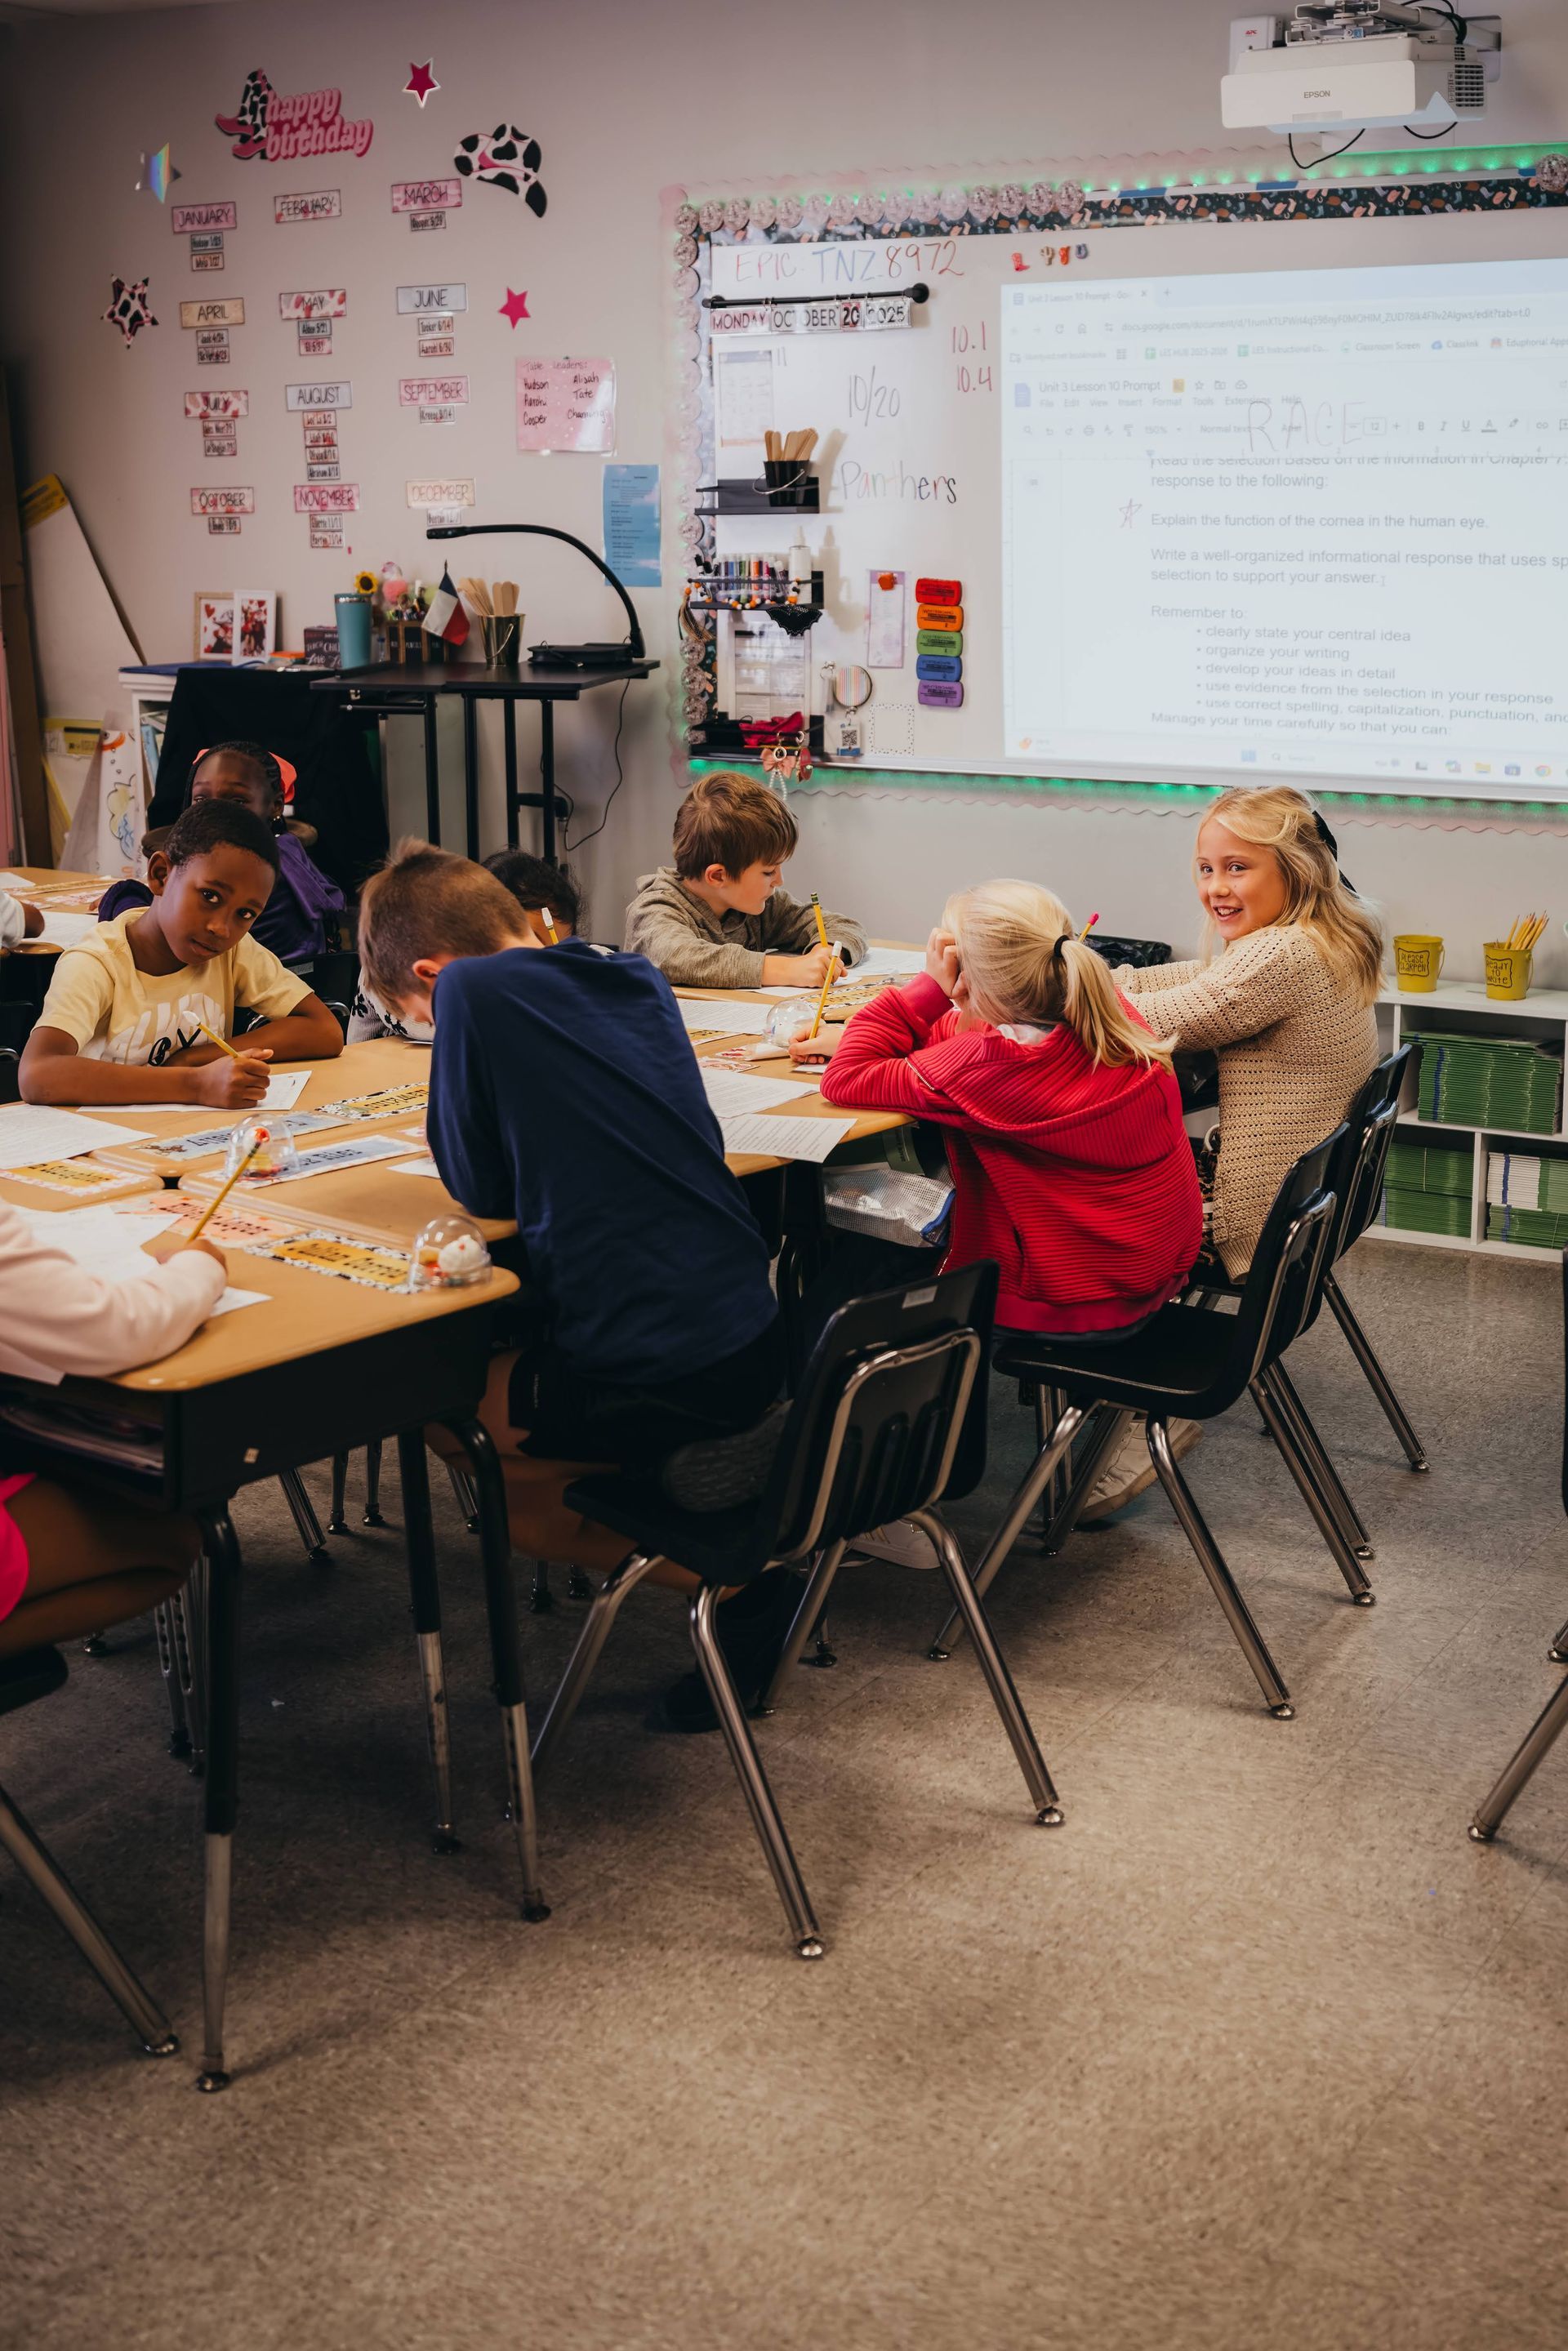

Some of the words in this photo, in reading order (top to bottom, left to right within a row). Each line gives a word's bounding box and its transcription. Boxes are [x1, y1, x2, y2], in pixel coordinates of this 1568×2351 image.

[1303, 90, 1331, 99] EPSON
[265, 87, 341, 123] happy
[265, 119, 372, 161] birthday
[403, 185, 448, 205] MARCH
[280, 196, 334, 216] FEBRUARY
[178, 208, 230, 228] JANUARY
[886, 240, 965, 279] 8972
[302, 294, 325, 312] MAY
[414, 288, 448, 308] JUNE
[197, 305, 229, 322] APRIL
[713, 312, 766, 331] MONDAY
[773, 309, 837, 328] OCBER
[842, 306, 860, 327] 20
[867, 305, 906, 324] 2025
[951, 321, 987, 354] 10.1
[523, 377, 550, 390] Hudson
[957, 366, 992, 393] 10.4
[1039, 382, 1060, 393] Unit
[1062, 381, 1068, 392] 3
[1071, 381, 1107, 393] Lesson
[1107, 380, 1120, 392] 10
[1123, 380, 1161, 394] Prompt
[297, 385, 341, 405] AUGUST
[403, 381, 464, 402] SEPTEMBER
[572, 387, 595, 401] Tate
[849, 365, 901, 427] 10/20
[1040, 399, 1054, 408] File
[1064, 398, 1080, 407] Edit
[1089, 399, 1108, 407] View
[1118, 398, 1143, 407] Insert
[1152, 397, 1183, 407] Format
[1192, 396, 1214, 407] Tools
[1225, 395, 1272, 407] Extensions
[1281, 394, 1302, 405] Help
[523, 411, 548, 430] Cooper
[1200, 424, 1232, 434] Normal
[1248, 399, 1366, 452] RACE
[1334, 457, 1352, 465] on
[840, 460, 957, 505] Panthers
[1151, 476, 1214, 490] response
[1218, 475, 1232, 487] to
[1236, 474, 1258, 487] the
[1263, 473, 1329, 490] following:
[198, 492, 246, 508] OCTOBER
[300, 488, 354, 507] NOVEMBER
[412, 483, 472, 504] DECEMBER
[1151, 513, 1197, 528] Explain
[1201, 514, 1221, 526] the
[1225, 514, 1275, 527] function
[1279, 514, 1292, 527] of
[1295, 514, 1315, 527] the
[1319, 516, 1365, 528] cornea
[1368, 514, 1380, 527] in
[1384, 514, 1405, 528] the
[1409, 514, 1456, 528] human
[1459, 517, 1490, 531] eye.
[1150, 548, 1187, 561] Write
[1190, 550, 1199, 561] a
[1203, 549, 1304, 566] well-organized
[1309, 550, 1401, 564] informational
[1405, 553, 1474, 568] response
[1478, 552, 1507, 565] that
[1511, 555, 1548, 568] uses
[1151, 568, 1212, 581] selection
[1215, 569, 1228, 581] to
[1233, 569, 1285, 585] support
[1289, 572, 1321, 586] your
[1324, 572, 1379, 584] answer.
[1151, 604, 1227, 619] Remember
[1205, 626, 1251, 640] clearly
[1254, 626, 1289, 639] state
[1293, 629, 1324, 642] your
[1328, 629, 1376, 642] central
[1380, 630, 1412, 643] idea
[1205, 646, 1265, 659] organize
[1269, 648, 1301, 660] your
[1304, 648, 1351, 661] writing
[1205, 662, 1260, 677] develop
[1263, 666, 1294, 678] your
[1298, 665, 1337, 678] ideas
[1341, 667, 1353, 679] in
[1357, 667, 1396, 680] detail
[1205, 682, 1231, 692] use
[1234, 682, 1297, 695] evidence
[1301, 683, 1333, 696] from
[1337, 685, 1359, 697] the
[1362, 686, 1428, 701] selection
[1431, 688, 1444, 701] in
[1448, 690, 1481, 704] your
[1483, 693, 1555, 706] response
[1205, 699, 1231, 709] use
[1234, 699, 1282, 712] correct
[1286, 701, 1344, 716] spelling,
[1348, 703, 1445, 720] capitalization,
[1449, 707, 1540, 724] punctuation,
[1151, 711, 1207, 727] Manage
[1209, 716, 1241, 728] your
[1244, 715, 1273, 728] time
[1276, 718, 1335, 733] carefully
[1339, 721, 1356, 732] so
[1360, 721, 1388, 733] that
[1391, 723, 1418, 736] you
